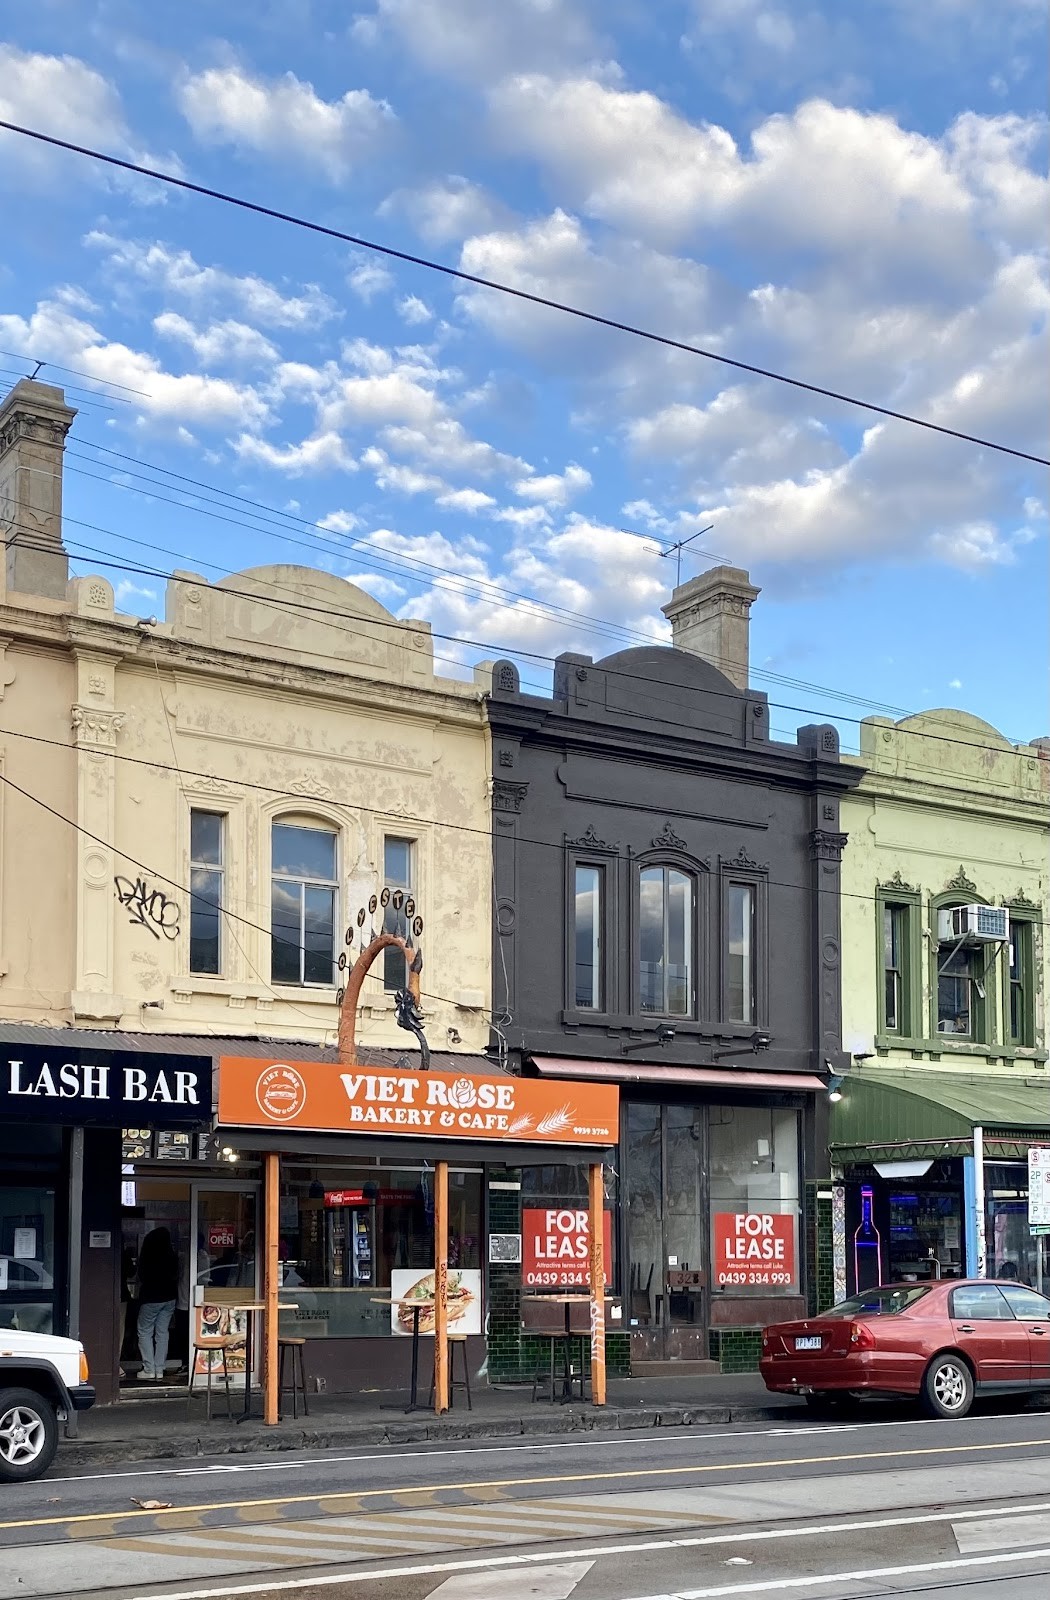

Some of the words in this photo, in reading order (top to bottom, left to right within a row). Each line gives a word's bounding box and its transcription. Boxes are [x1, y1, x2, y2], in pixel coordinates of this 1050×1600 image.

[8, 1060, 110, 1099] LASH
[122, 1067, 200, 1105] BAR
[262, 1070, 279, 1086] VIET
[339, 1073, 420, 1104] VIET
[350, 1105, 436, 1126] BAKERY
[439, 1111, 456, 1127] &
[458, 1112, 509, 1131] CAFE
[572, 1126, 591, 1135] 9939
[546, 1210, 589, 1233] FOR
[735, 1214, 774, 1235] FOR
[210, 1235, 234, 1245] OPEN
[535, 1236, 588, 1258] LEAS
[725, 1238, 785, 1260] LEASE
[536, 1261, 561, 1269] Attractive
[577, 1261, 587, 1269] call
[527, 1272, 558, 1285] 0439
[560, 1272, 583, 1285] 334
[585, 1272, 607, 1285] 93
[719, 1272, 747, 1284] 0439
[748, 1272, 769, 1284] 334
[771, 1272, 791, 1284] 993
